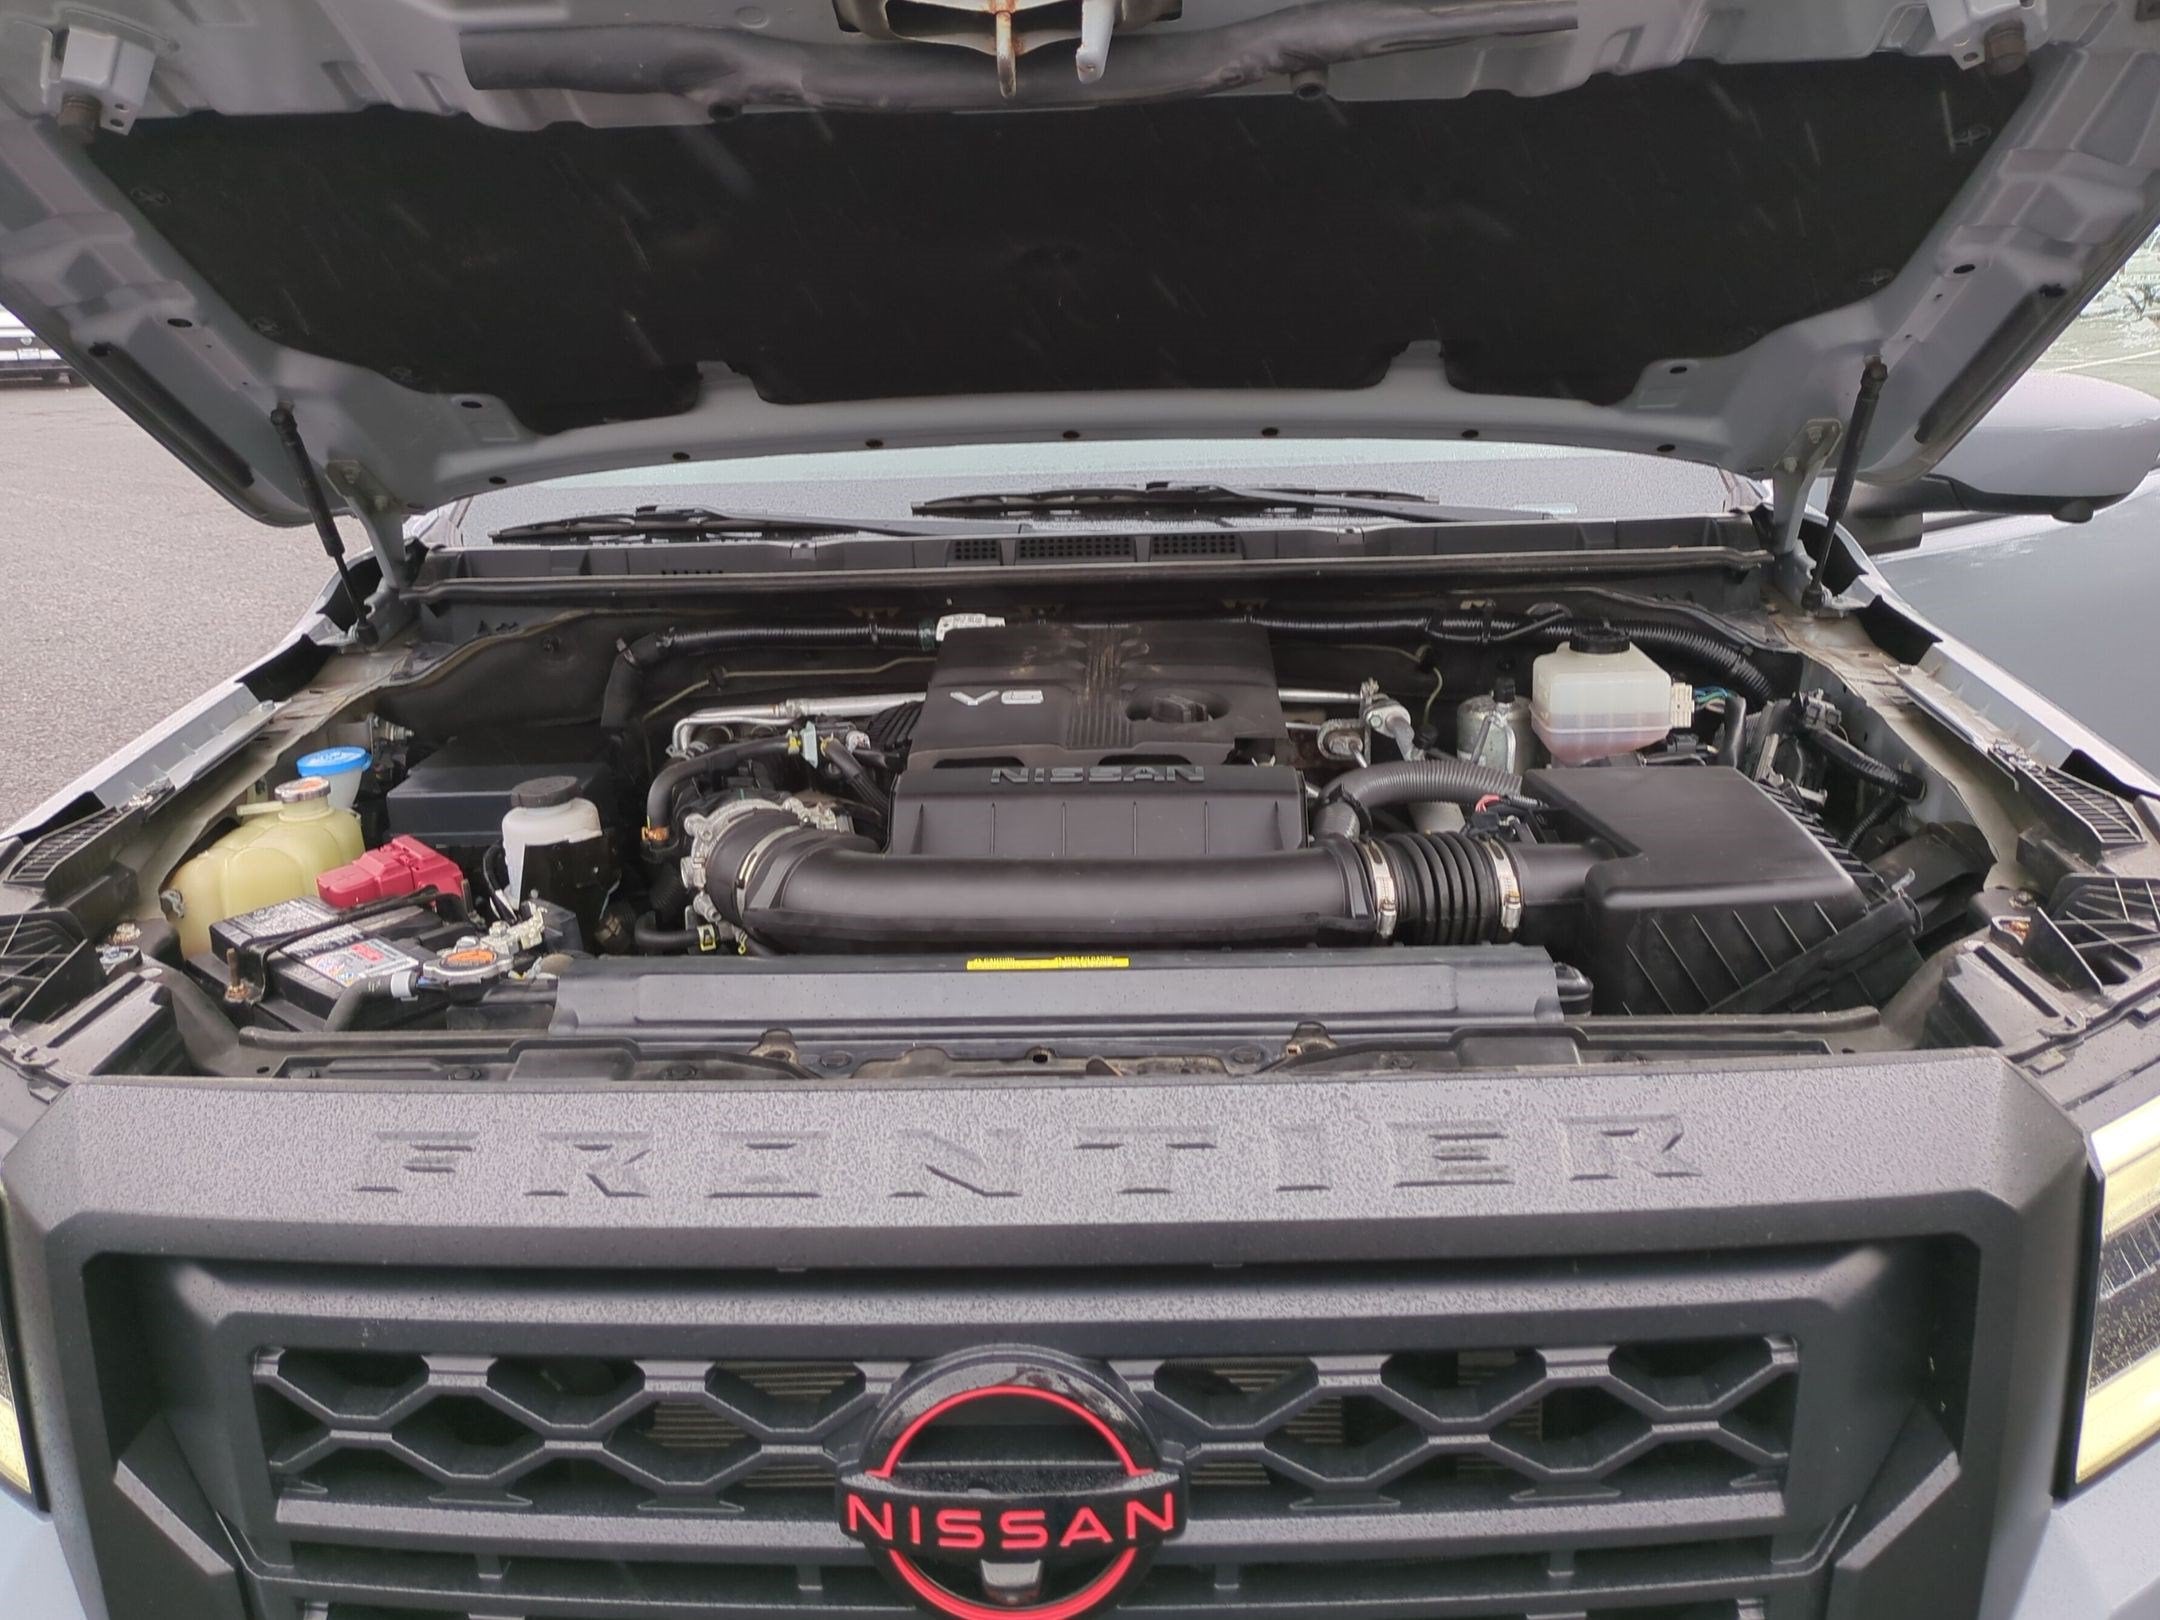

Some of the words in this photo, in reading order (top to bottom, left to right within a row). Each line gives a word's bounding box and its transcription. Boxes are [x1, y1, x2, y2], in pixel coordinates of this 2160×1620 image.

[950, 689, 1045, 706] V6
[990, 766, 1205, 784] NISSAN
[353, 1113, 1703, 1198] FRONTIER
[848, 1492, 1174, 1549] NISSAN
